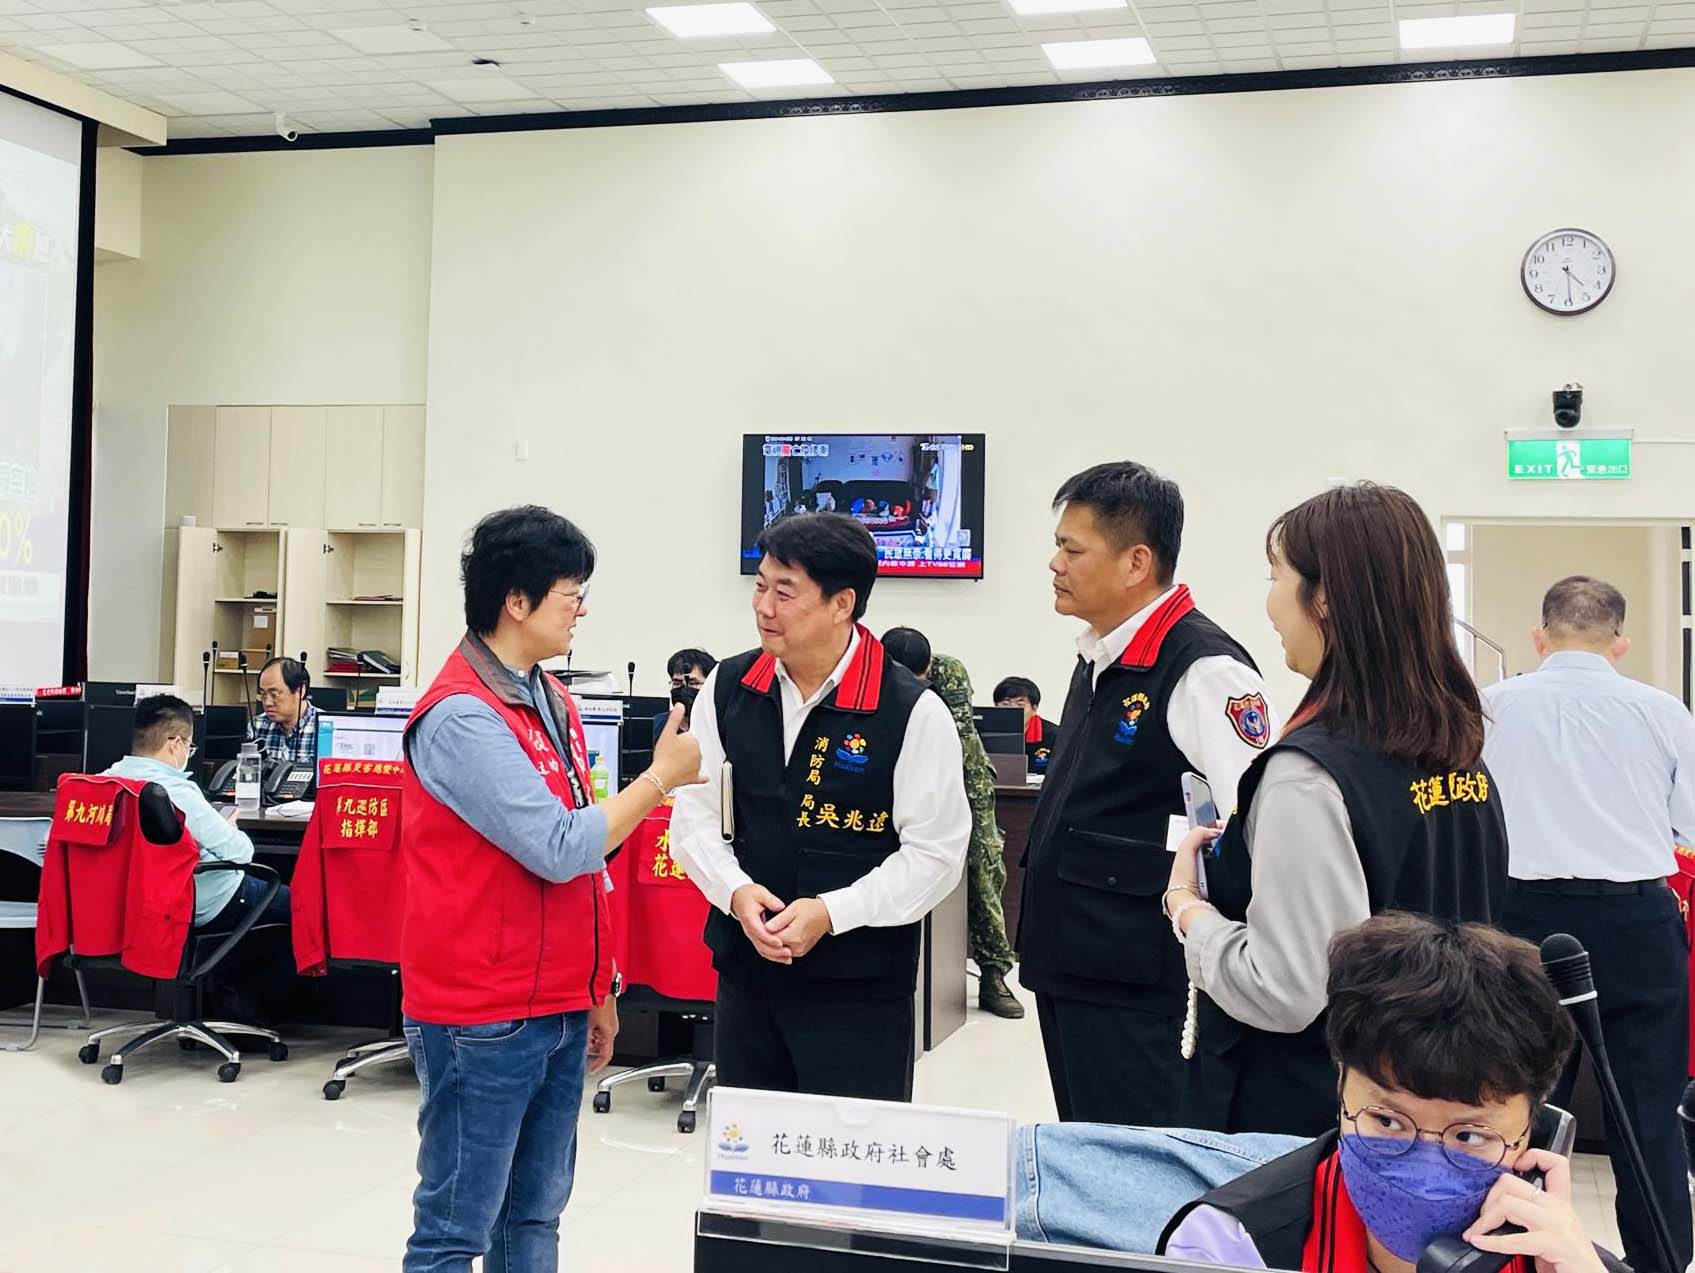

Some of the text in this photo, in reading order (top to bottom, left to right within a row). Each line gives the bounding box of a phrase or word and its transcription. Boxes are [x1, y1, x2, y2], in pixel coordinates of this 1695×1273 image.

[1546, 241, 1555, 252] 11
[1562, 237, 1574, 247] 12
[1534, 255, 1545, 265] 10
[1529, 269, 1539, 278] 9
[1534, 283, 1543, 293] 8
[1547, 294, 1555, 304] 7
[1514, 464, 1553, 474] EXIT
[796, 736, 830, 828] 消防局 局長
[64, 799, 113, 826] 第九河川局
[341, 818, 379, 839] 指揮部
[771, 1133, 958, 1171] 花蓮縣政府社會處
[733, 1177, 811, 1200] 花蓮縣政府
